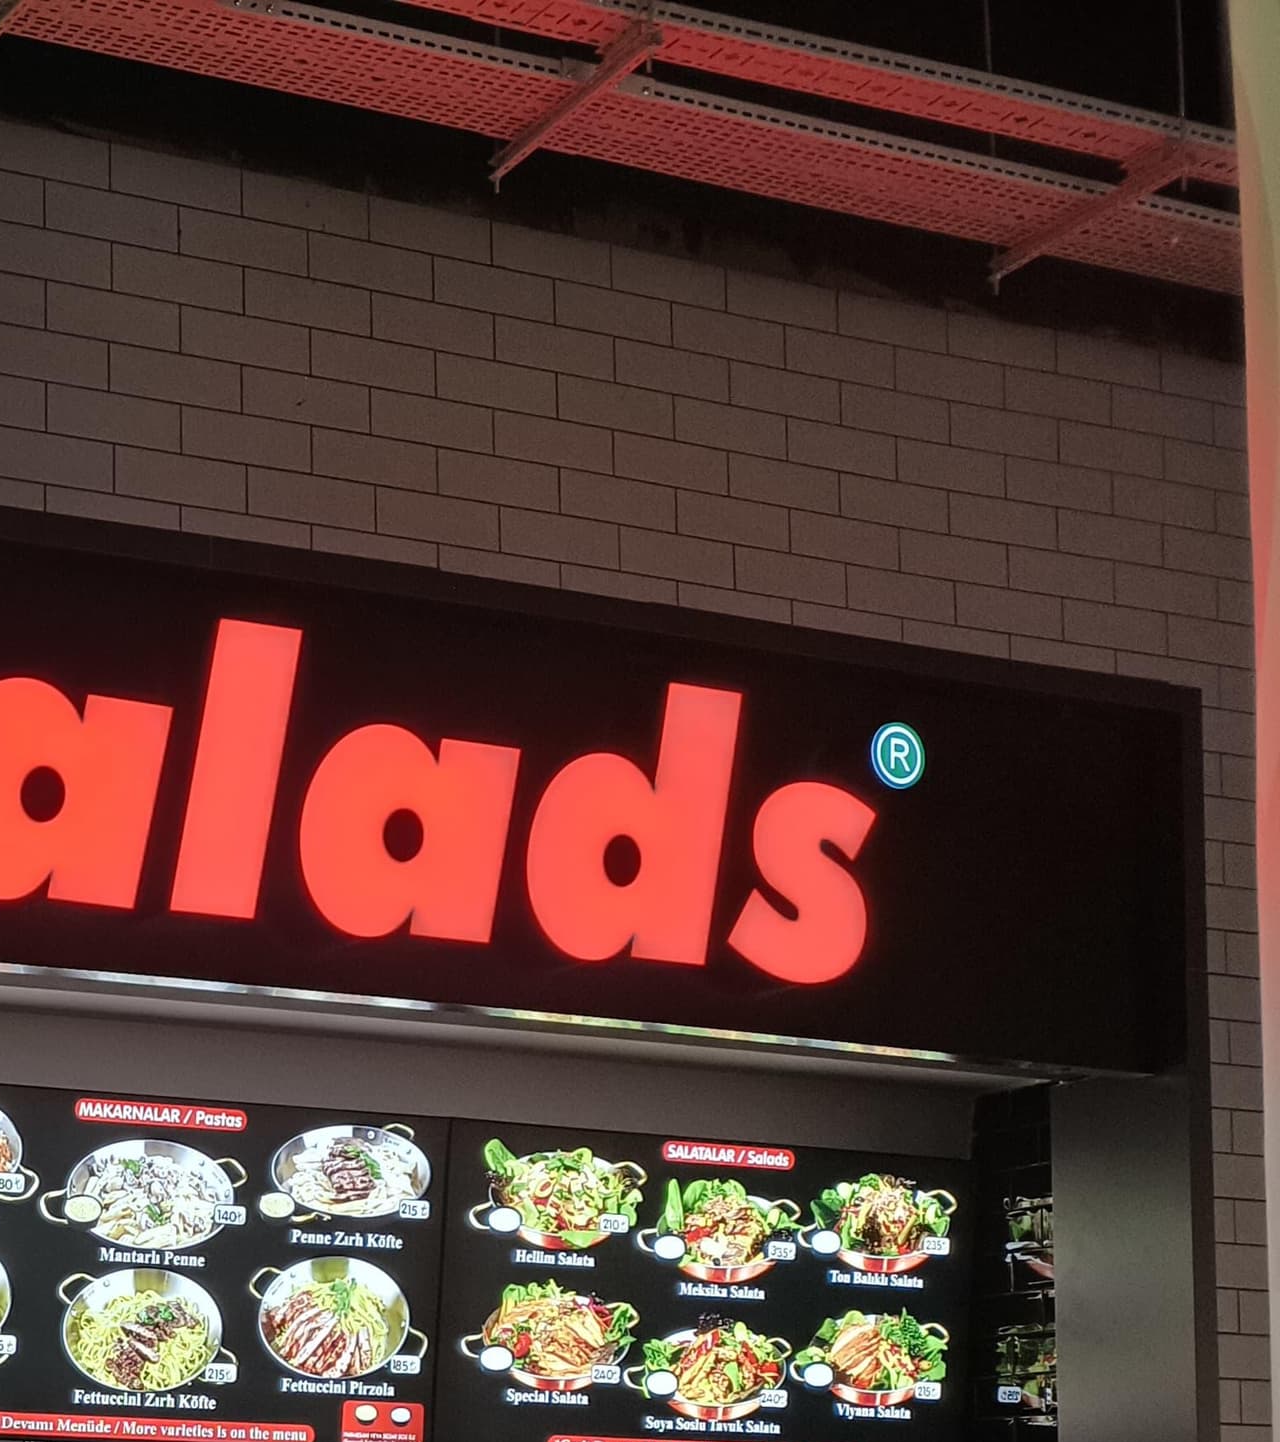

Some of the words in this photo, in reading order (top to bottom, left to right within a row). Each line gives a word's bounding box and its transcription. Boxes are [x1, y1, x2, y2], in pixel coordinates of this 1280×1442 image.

[78, 1102, 181, 1123] MAKARNALAR
[195, 1109, 243, 1128] Pastas
[667, 1143, 736, 1163] SALATALAR
[747, 1151, 790, 1168] Salads
[290, 1229, 332, 1246] Penne
[367, 1232, 403, 1250] Köfte
[163, 1250, 206, 1267] Penne
[557, 1251, 596, 1268] Salata
[890, 1274, 924, 1290] Salata
[730, 1285, 766, 1301] Salata
[281, 1377, 347, 1396] Fettuccini
[348, 1380, 395, 1397] Pirzola
[74, 1389, 142, 1407] Fettuccini
[178, 1394, 217, 1411] Köfte
[506, 1388, 550, 1407] Special
[551, 1390, 590, 1406] Salata
[876, 1404, 912, 1421] Salata
[1, 1416, 54, 1432] Devamı
[56, 1418, 111, 1434] Menüde
[122, 1421, 158, 1437] More
[160, 1423, 214, 1439] varieties
[230, 1427, 247, 1440] on
[249, 1427, 270, 1441] the
[272, 1429, 307, 1442] menu
[644, 1415, 674, 1433] Soya
[675, 1416, 707, 1432] Soslu
[708, 1418, 744, 1434] Tavuk
[745, 1419, 781, 1435] Salata
